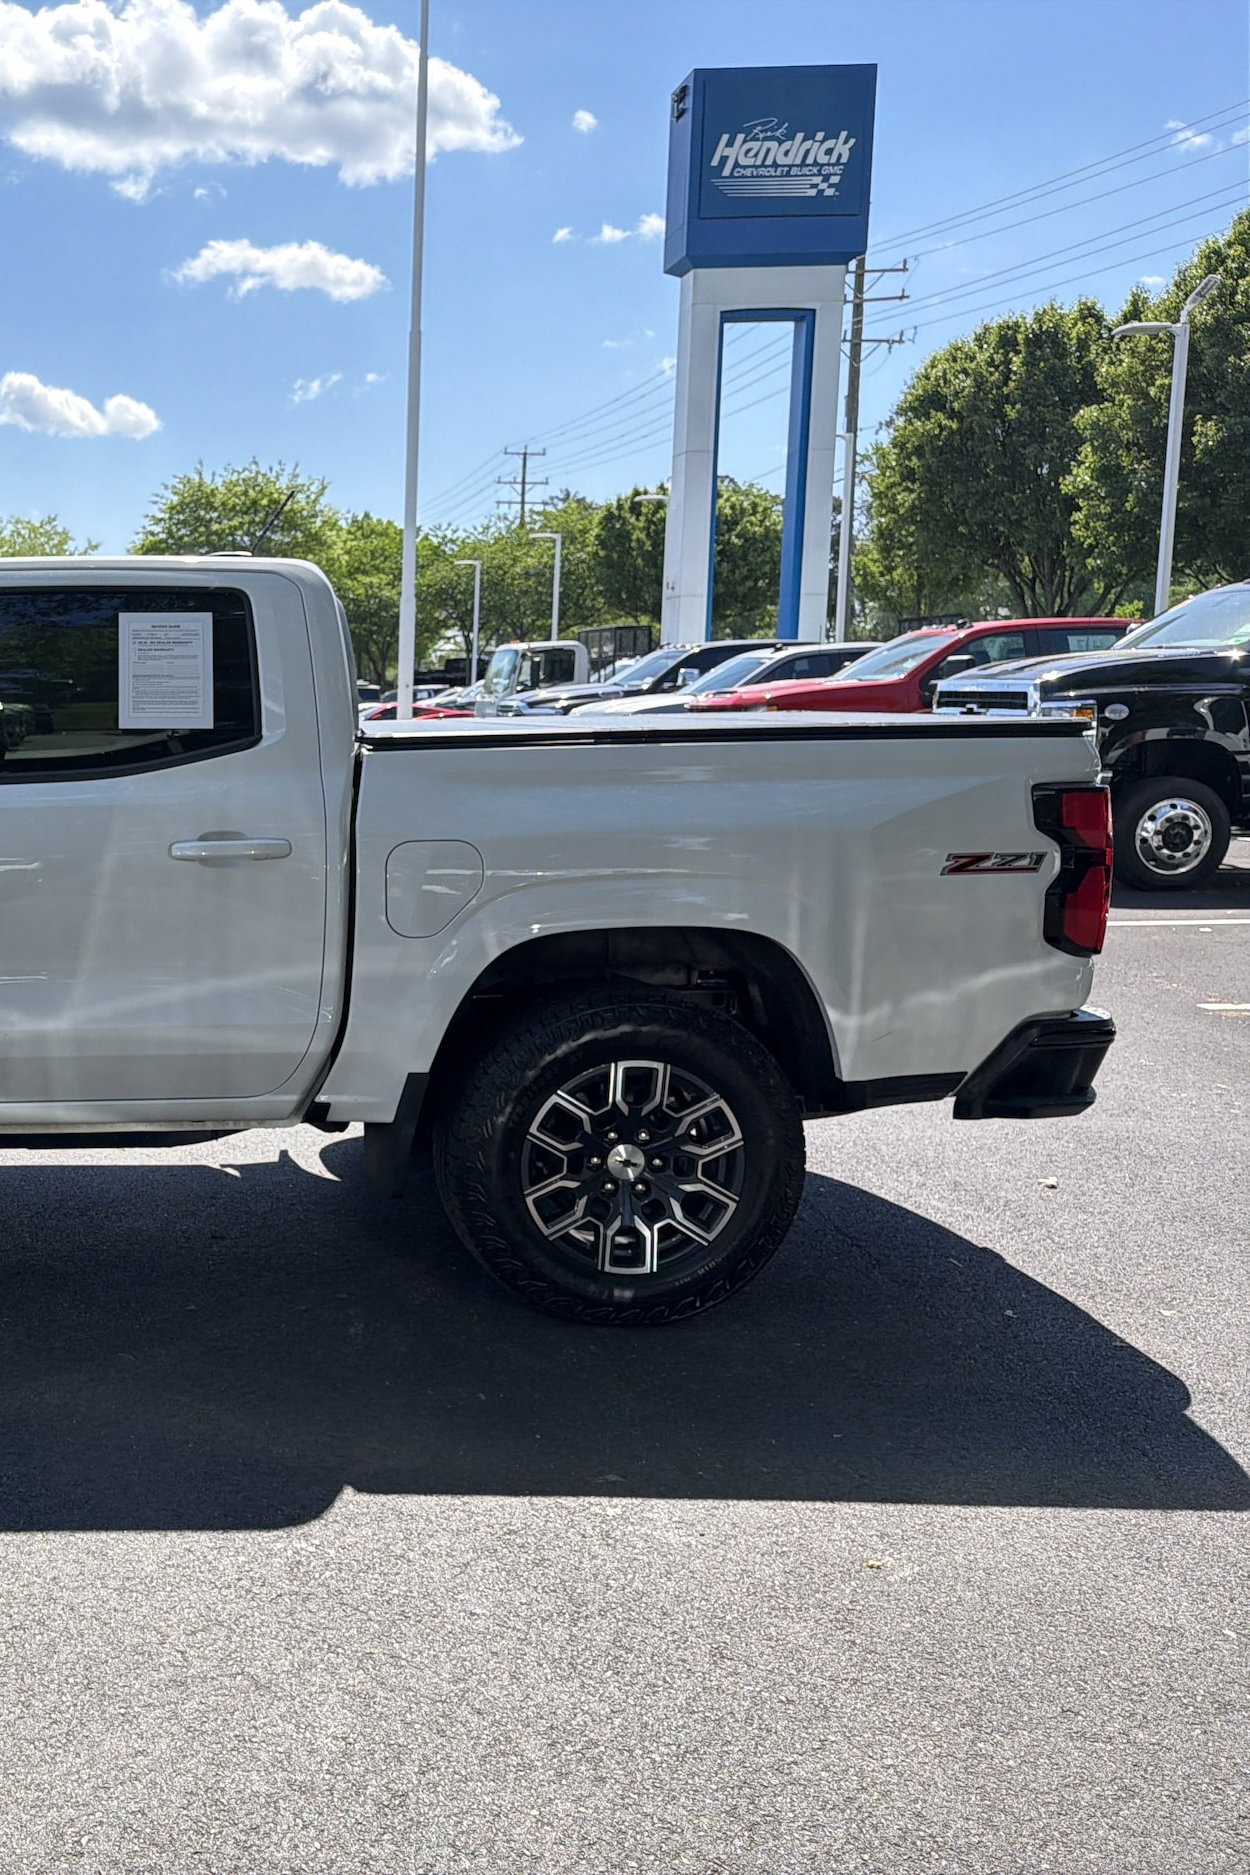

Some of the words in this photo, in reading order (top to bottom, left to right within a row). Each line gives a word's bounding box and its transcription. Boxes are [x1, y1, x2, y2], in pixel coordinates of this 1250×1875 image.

[710, 130, 856, 177] Hendrick
[733, 167, 790, 177] CHEVROLET
[790, 166, 820, 176] BUICK
[821, 165, 845, 175] GMC
[940, 851, 1048, 876] Z71
